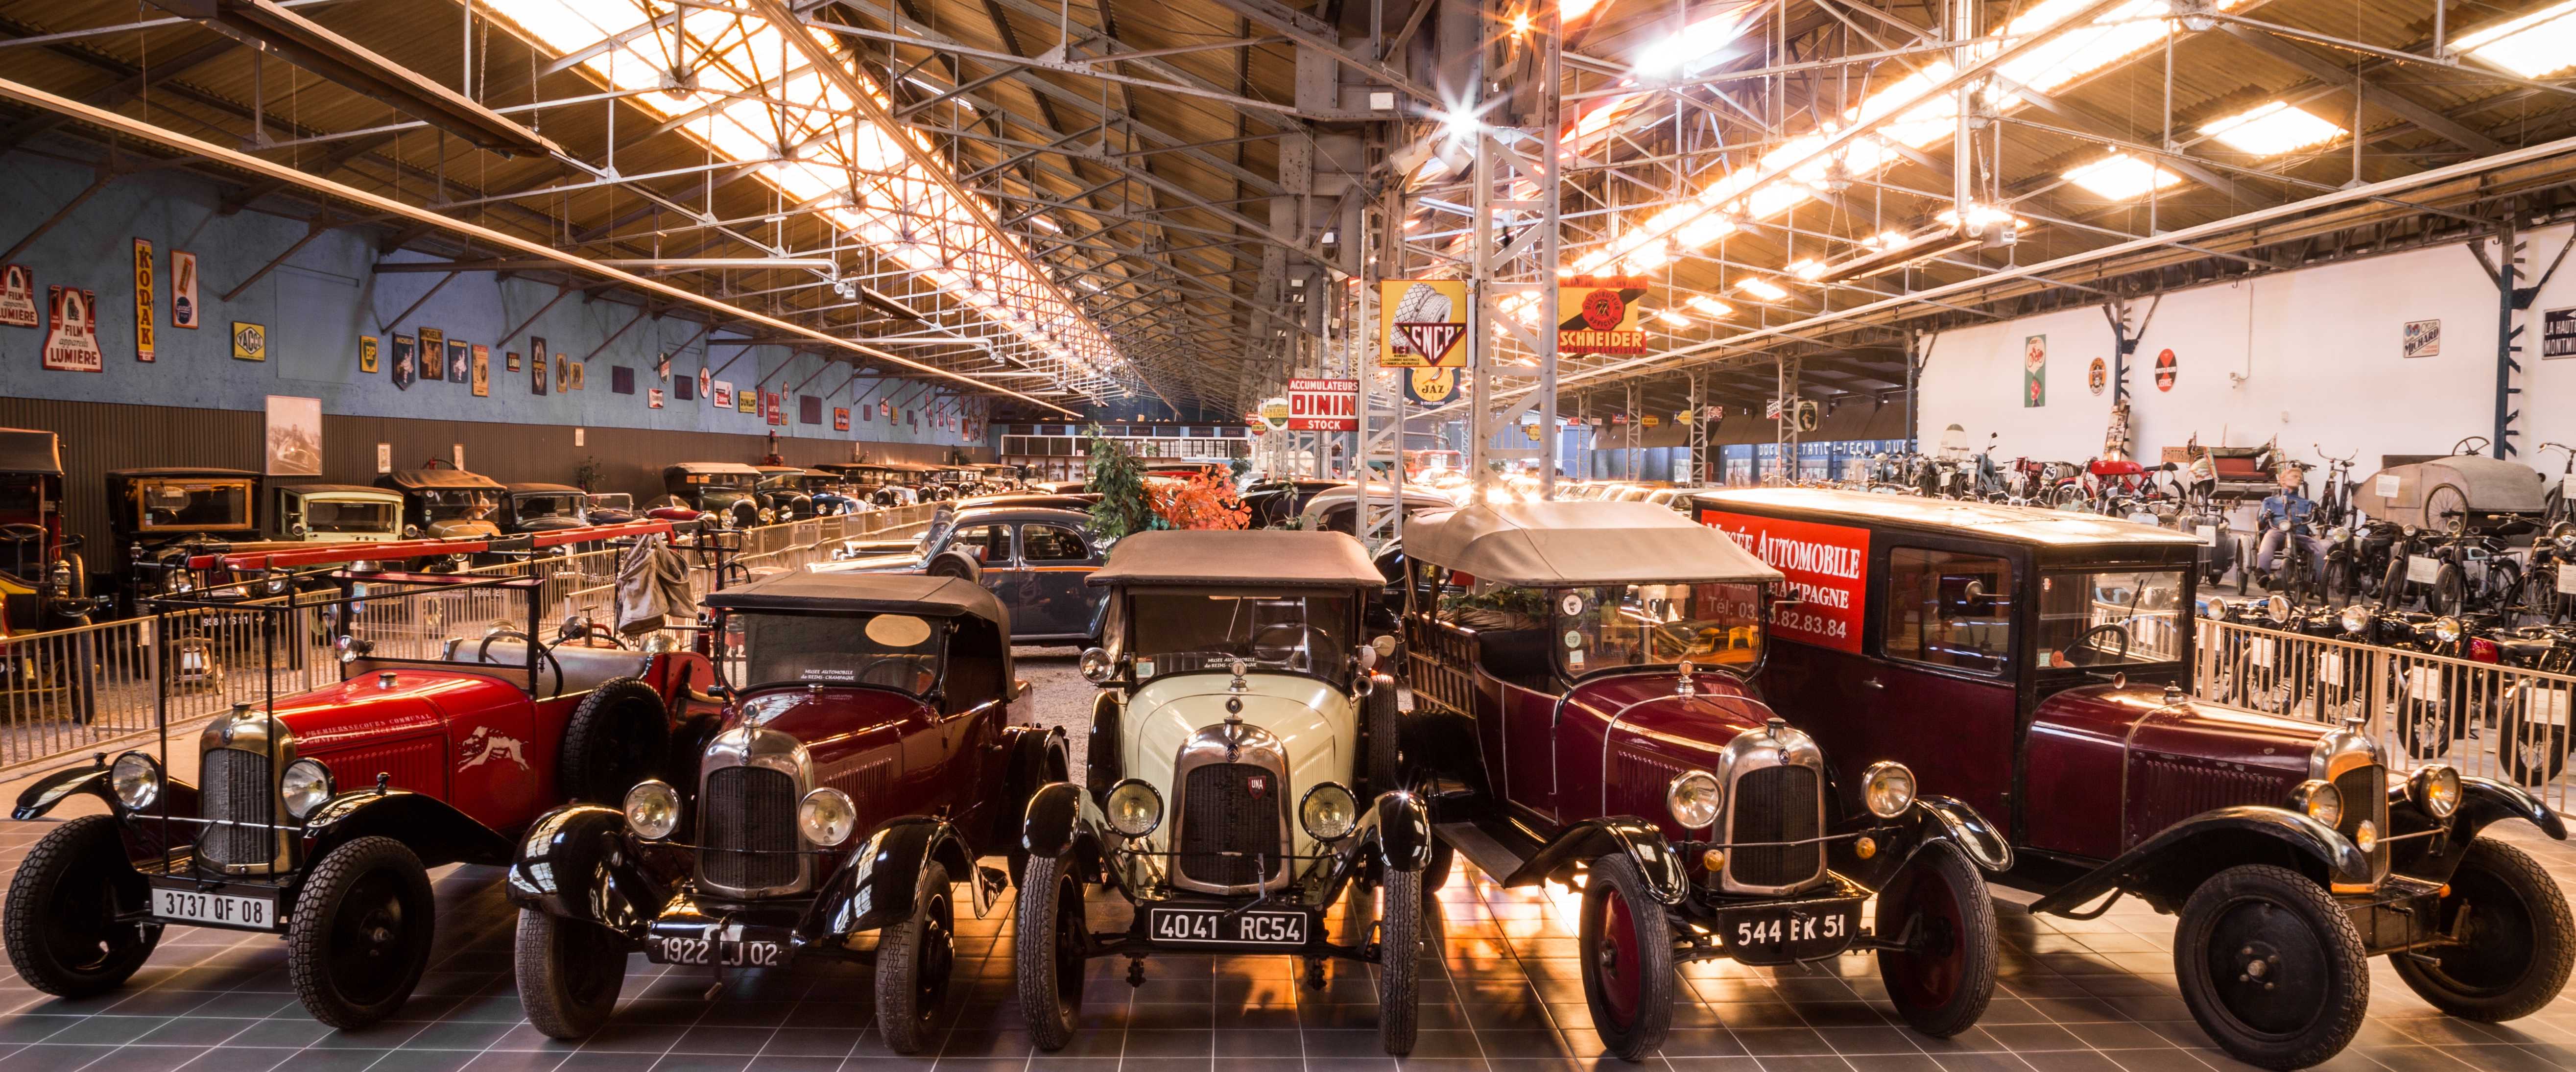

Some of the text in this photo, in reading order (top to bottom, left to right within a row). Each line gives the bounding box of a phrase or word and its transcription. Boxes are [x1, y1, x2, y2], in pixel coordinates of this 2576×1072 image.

[8, 291, 24, 301] FILM
[139, 250, 151, 345] KODAK
[1590, 316, 1617, 327] OFFICIEL
[2545, 321, 2554, 335] LA
[65, 324, 83, 337] FILM
[59, 338, 88, 349] appareils
[236, 330, 264, 352] YACCO
[1412, 326, 1454, 360] SNCP
[1560, 331, 1643, 347] SCHNEIDER
[2405, 327, 2438, 356] MICHARD
[50, 348, 97, 365] LUMIÈRE
[366, 346, 375, 360] BP
[1289, 380, 1358, 391] ACCUMULATEURS
[1422, 385, 1444, 393] JAZ
[1292, 395, 1356, 416] DININ
[1308, 420, 1341, 429] STOCK
[1757, 529, 1860, 579] AUTOMOBILE
[389, 714, 431, 724] COMMUNAL
[1251, 780, 1263, 789] UNA
[166, 893, 262, 923] 3737 QF 08
[1240, 917, 1300, 940] RC54
[1738, 920, 1781, 946] 544
[1823, 914, 1844, 937] 51
[662, 937, 709, 963] 1922
[751, 943, 777, 966] 02
